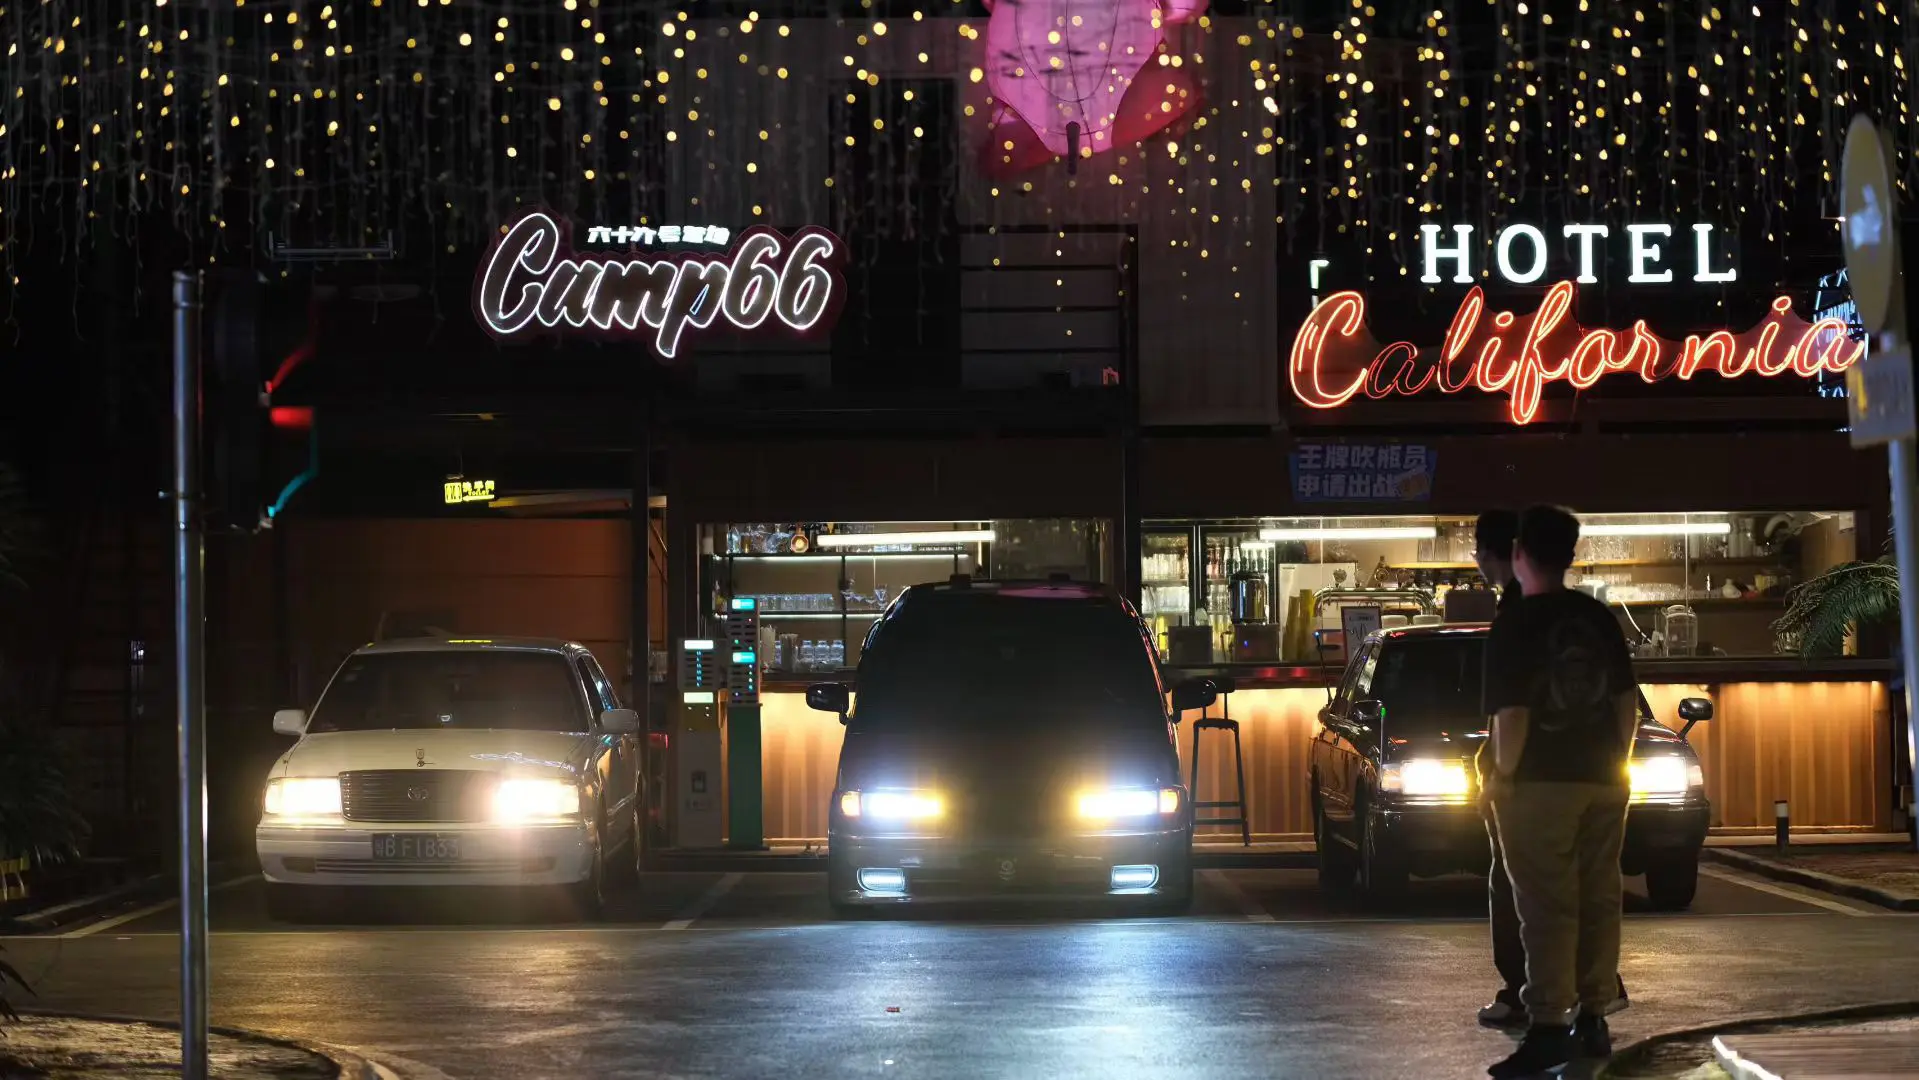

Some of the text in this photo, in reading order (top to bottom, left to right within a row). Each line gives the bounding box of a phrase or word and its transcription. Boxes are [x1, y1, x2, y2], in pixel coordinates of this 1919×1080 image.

[1420, 222, 1738, 284] HOTEL
[481, 212, 833, 358] Camp66
[1289, 280, 1865, 426] California
[1298, 444, 1428, 470] 王牌吹瓶员
[1298, 473, 1403, 498] 申请出战
